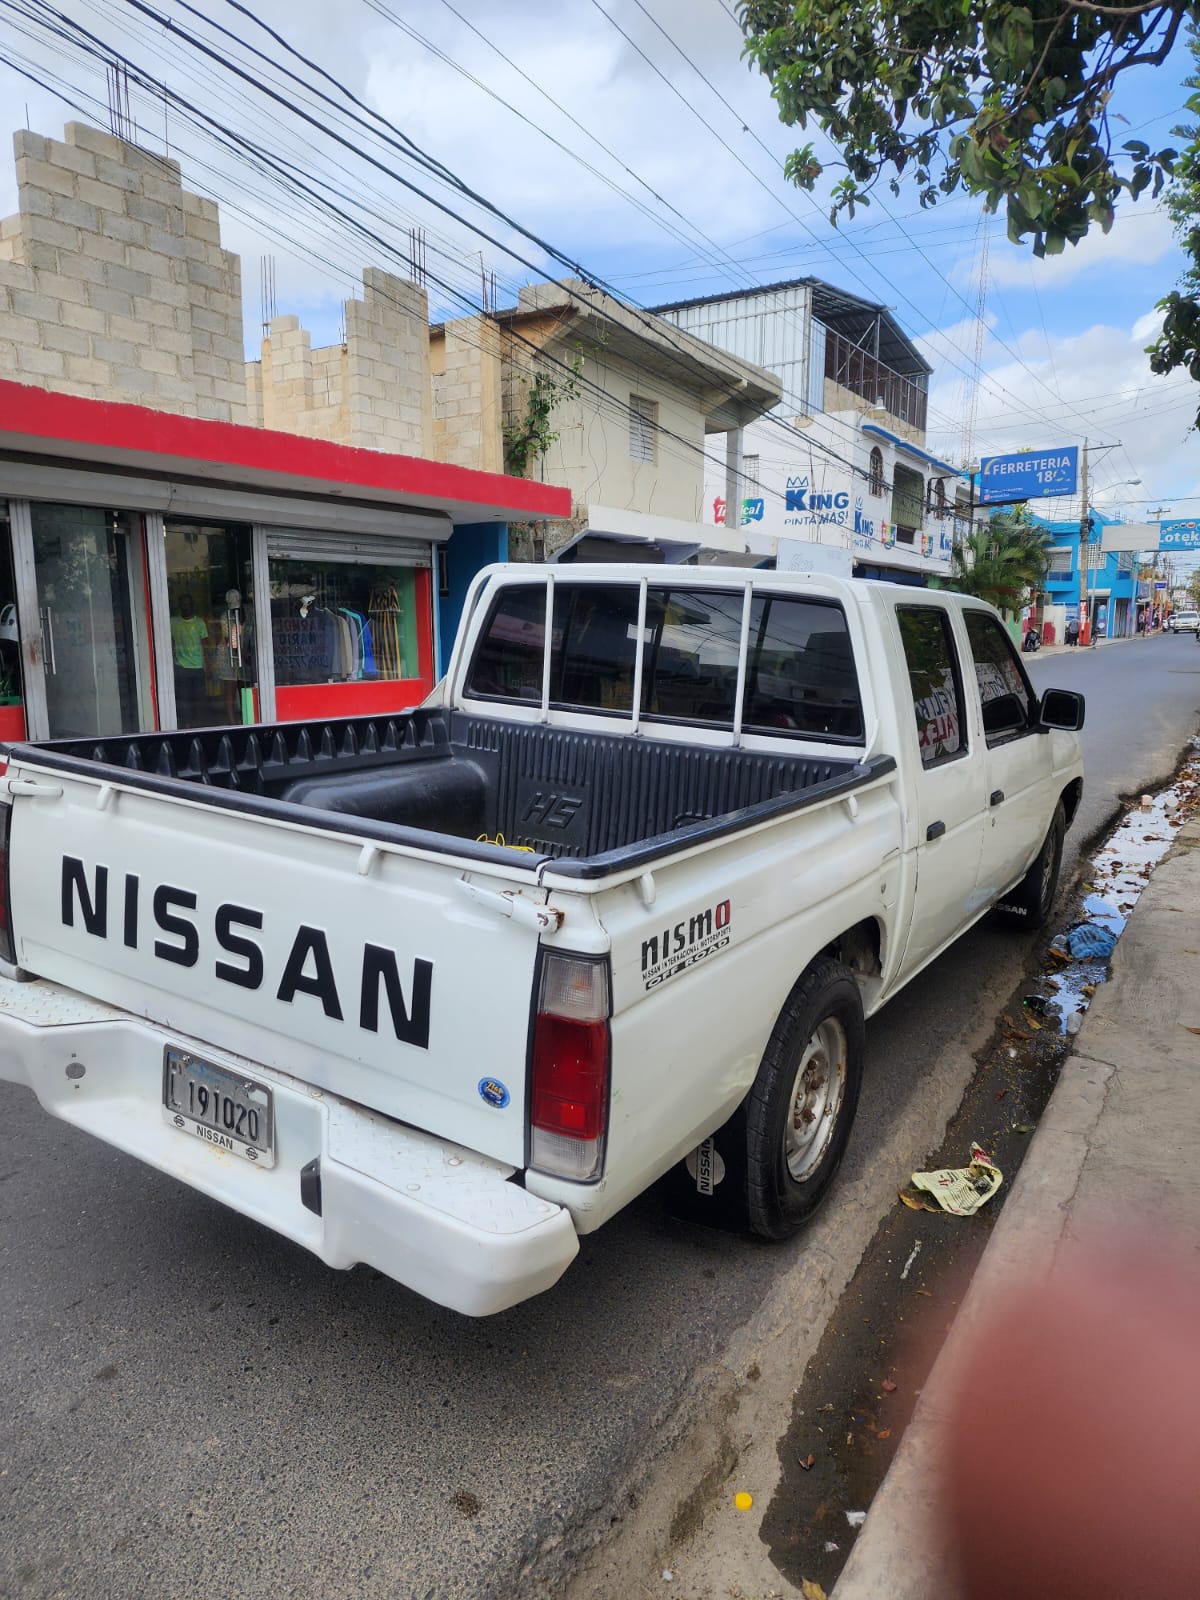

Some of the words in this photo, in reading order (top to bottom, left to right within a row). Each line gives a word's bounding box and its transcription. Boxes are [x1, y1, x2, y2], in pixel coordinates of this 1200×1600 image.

[992, 456, 1071, 475] FERRETERIA
[785, 488, 849, 511] KING
[784, 513, 817, 526] PINTA
[854, 510, 874, 537] KING
[641, 899, 731, 972] nismo
[62, 855, 434, 1050] NISSAN
[685, 938, 728, 968] ROAD
[642, 965, 661, 981] NISSAN
[189, 1080, 259, 1141] 191020
[196, 1125, 233, 1150] NISSAN
